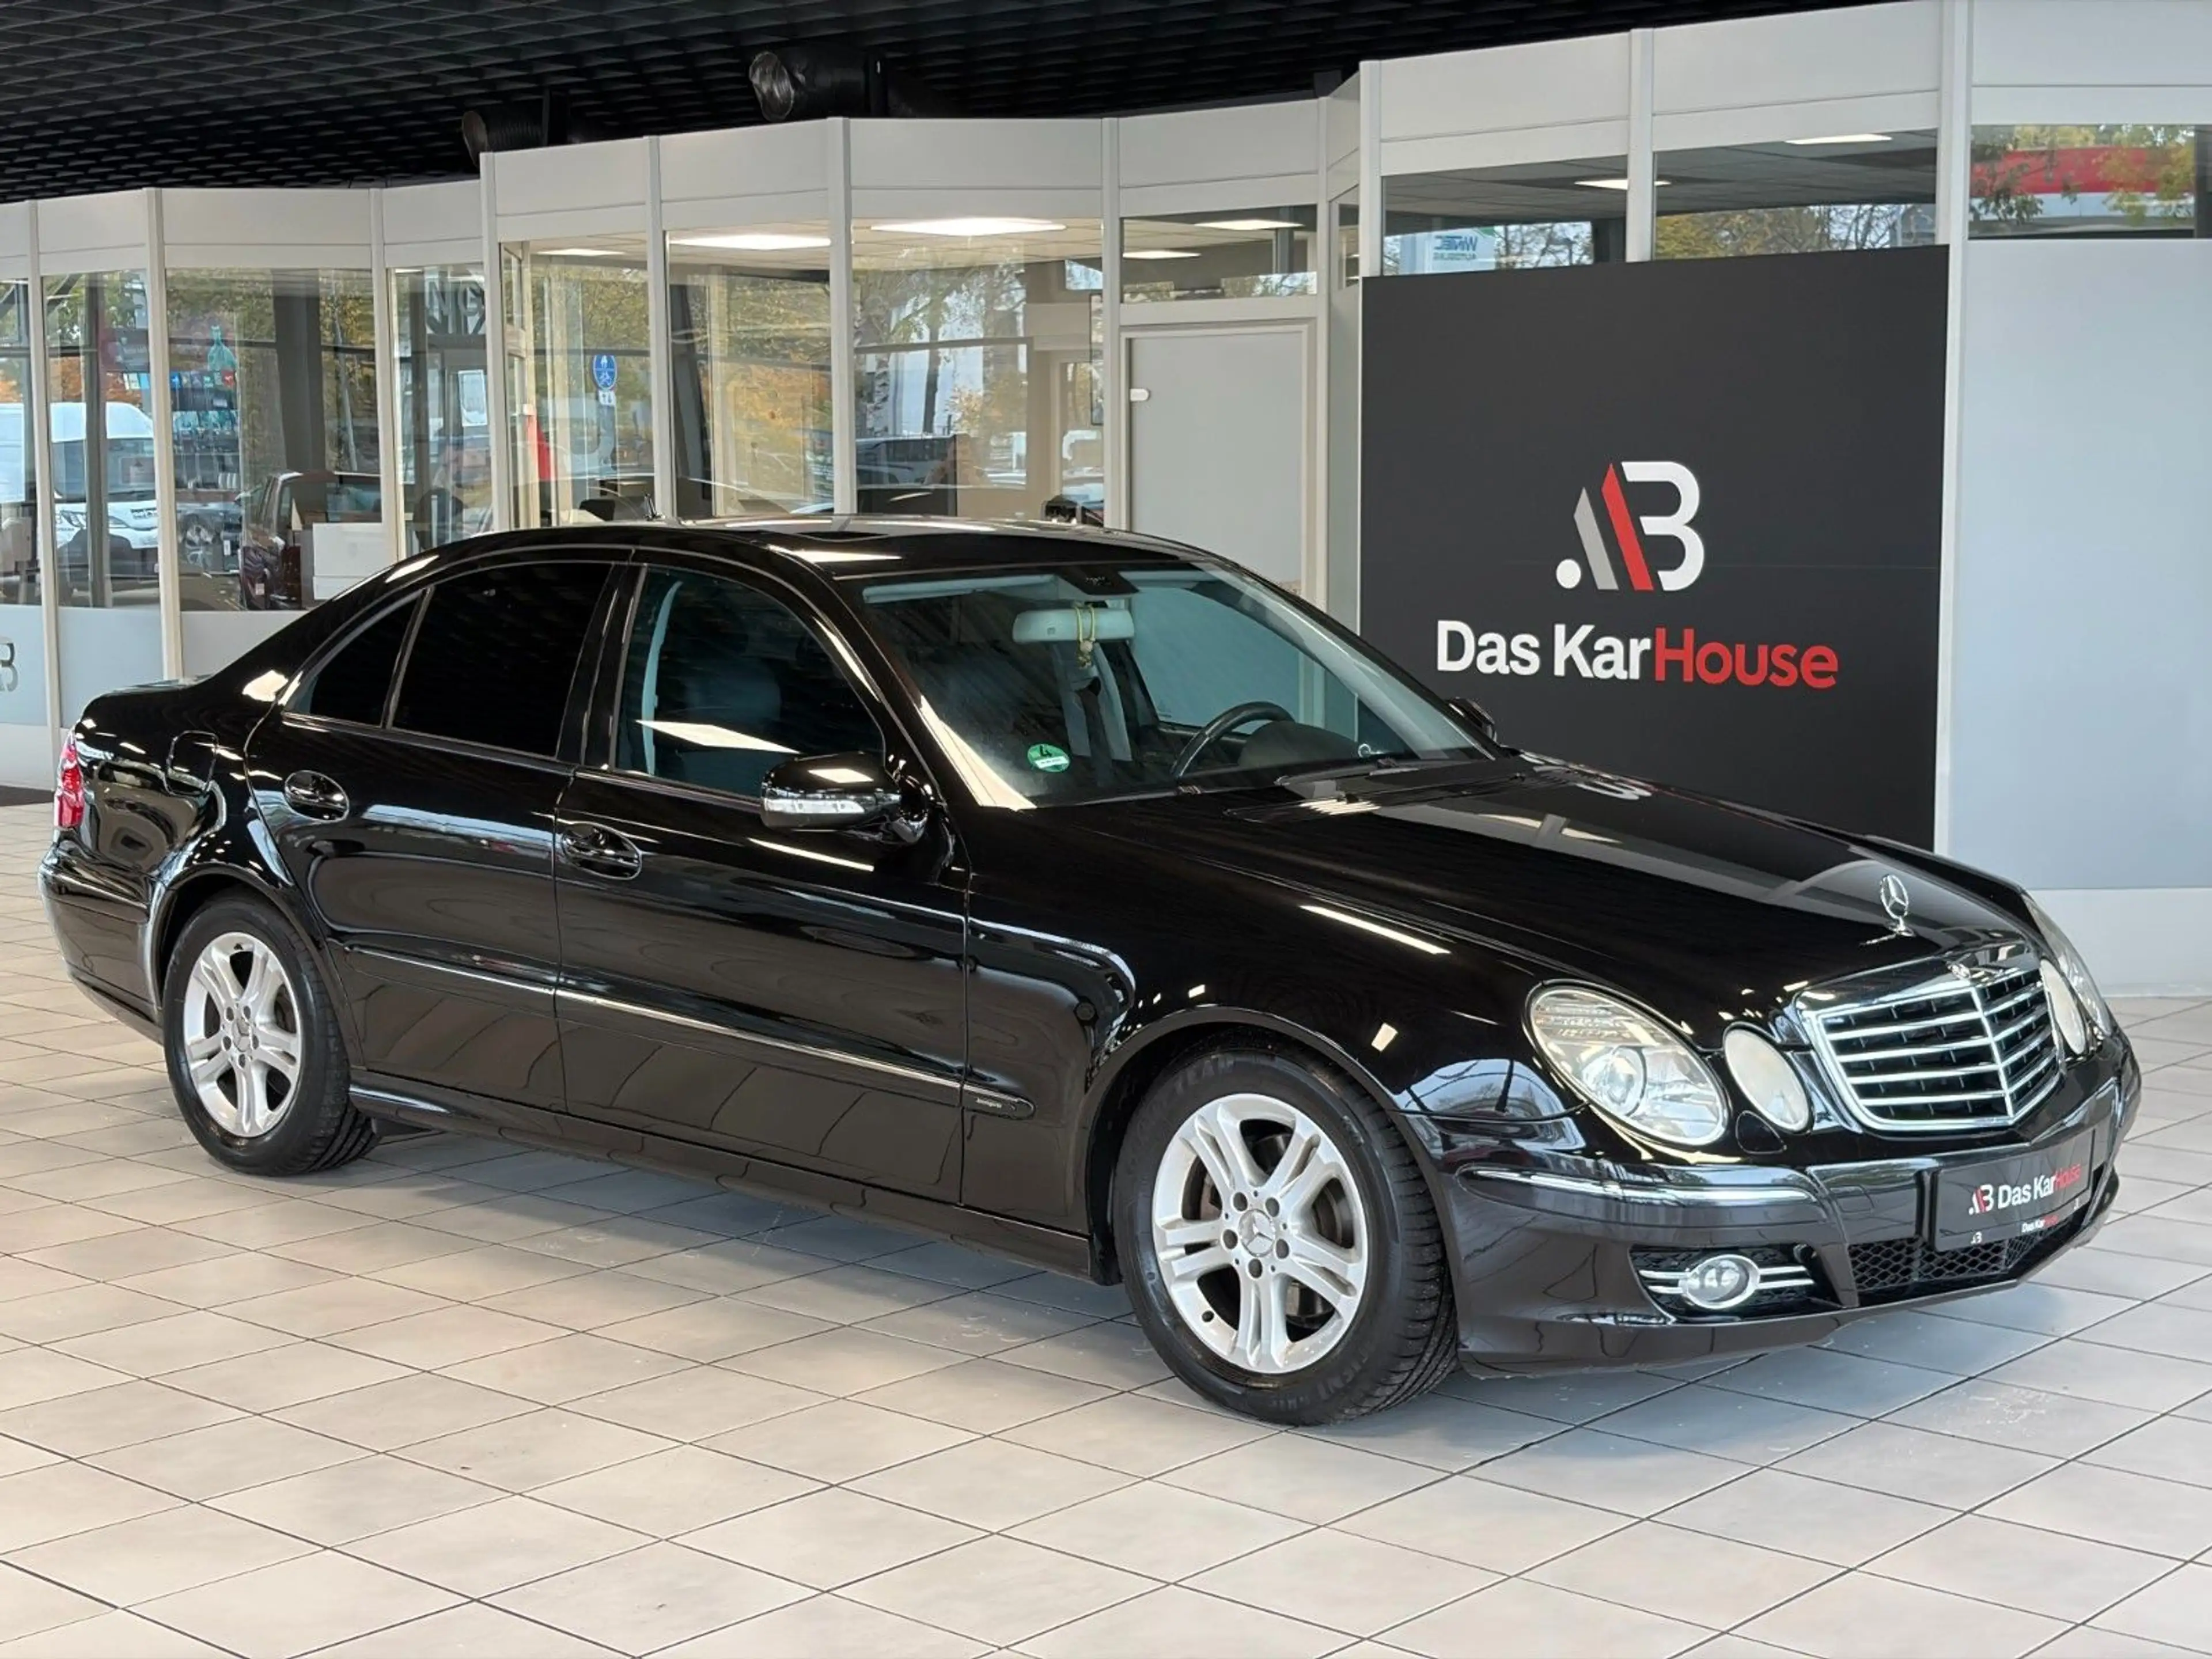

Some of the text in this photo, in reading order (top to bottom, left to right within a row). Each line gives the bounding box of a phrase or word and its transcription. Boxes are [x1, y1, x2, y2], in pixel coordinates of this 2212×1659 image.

[1437, 619, 1839, 688] Das KarHouse
[1040, 745, 1052, 756] 4
[1998, 1184, 2032, 1209] Das
[2033, 1164, 2081, 1200] KarHouse
